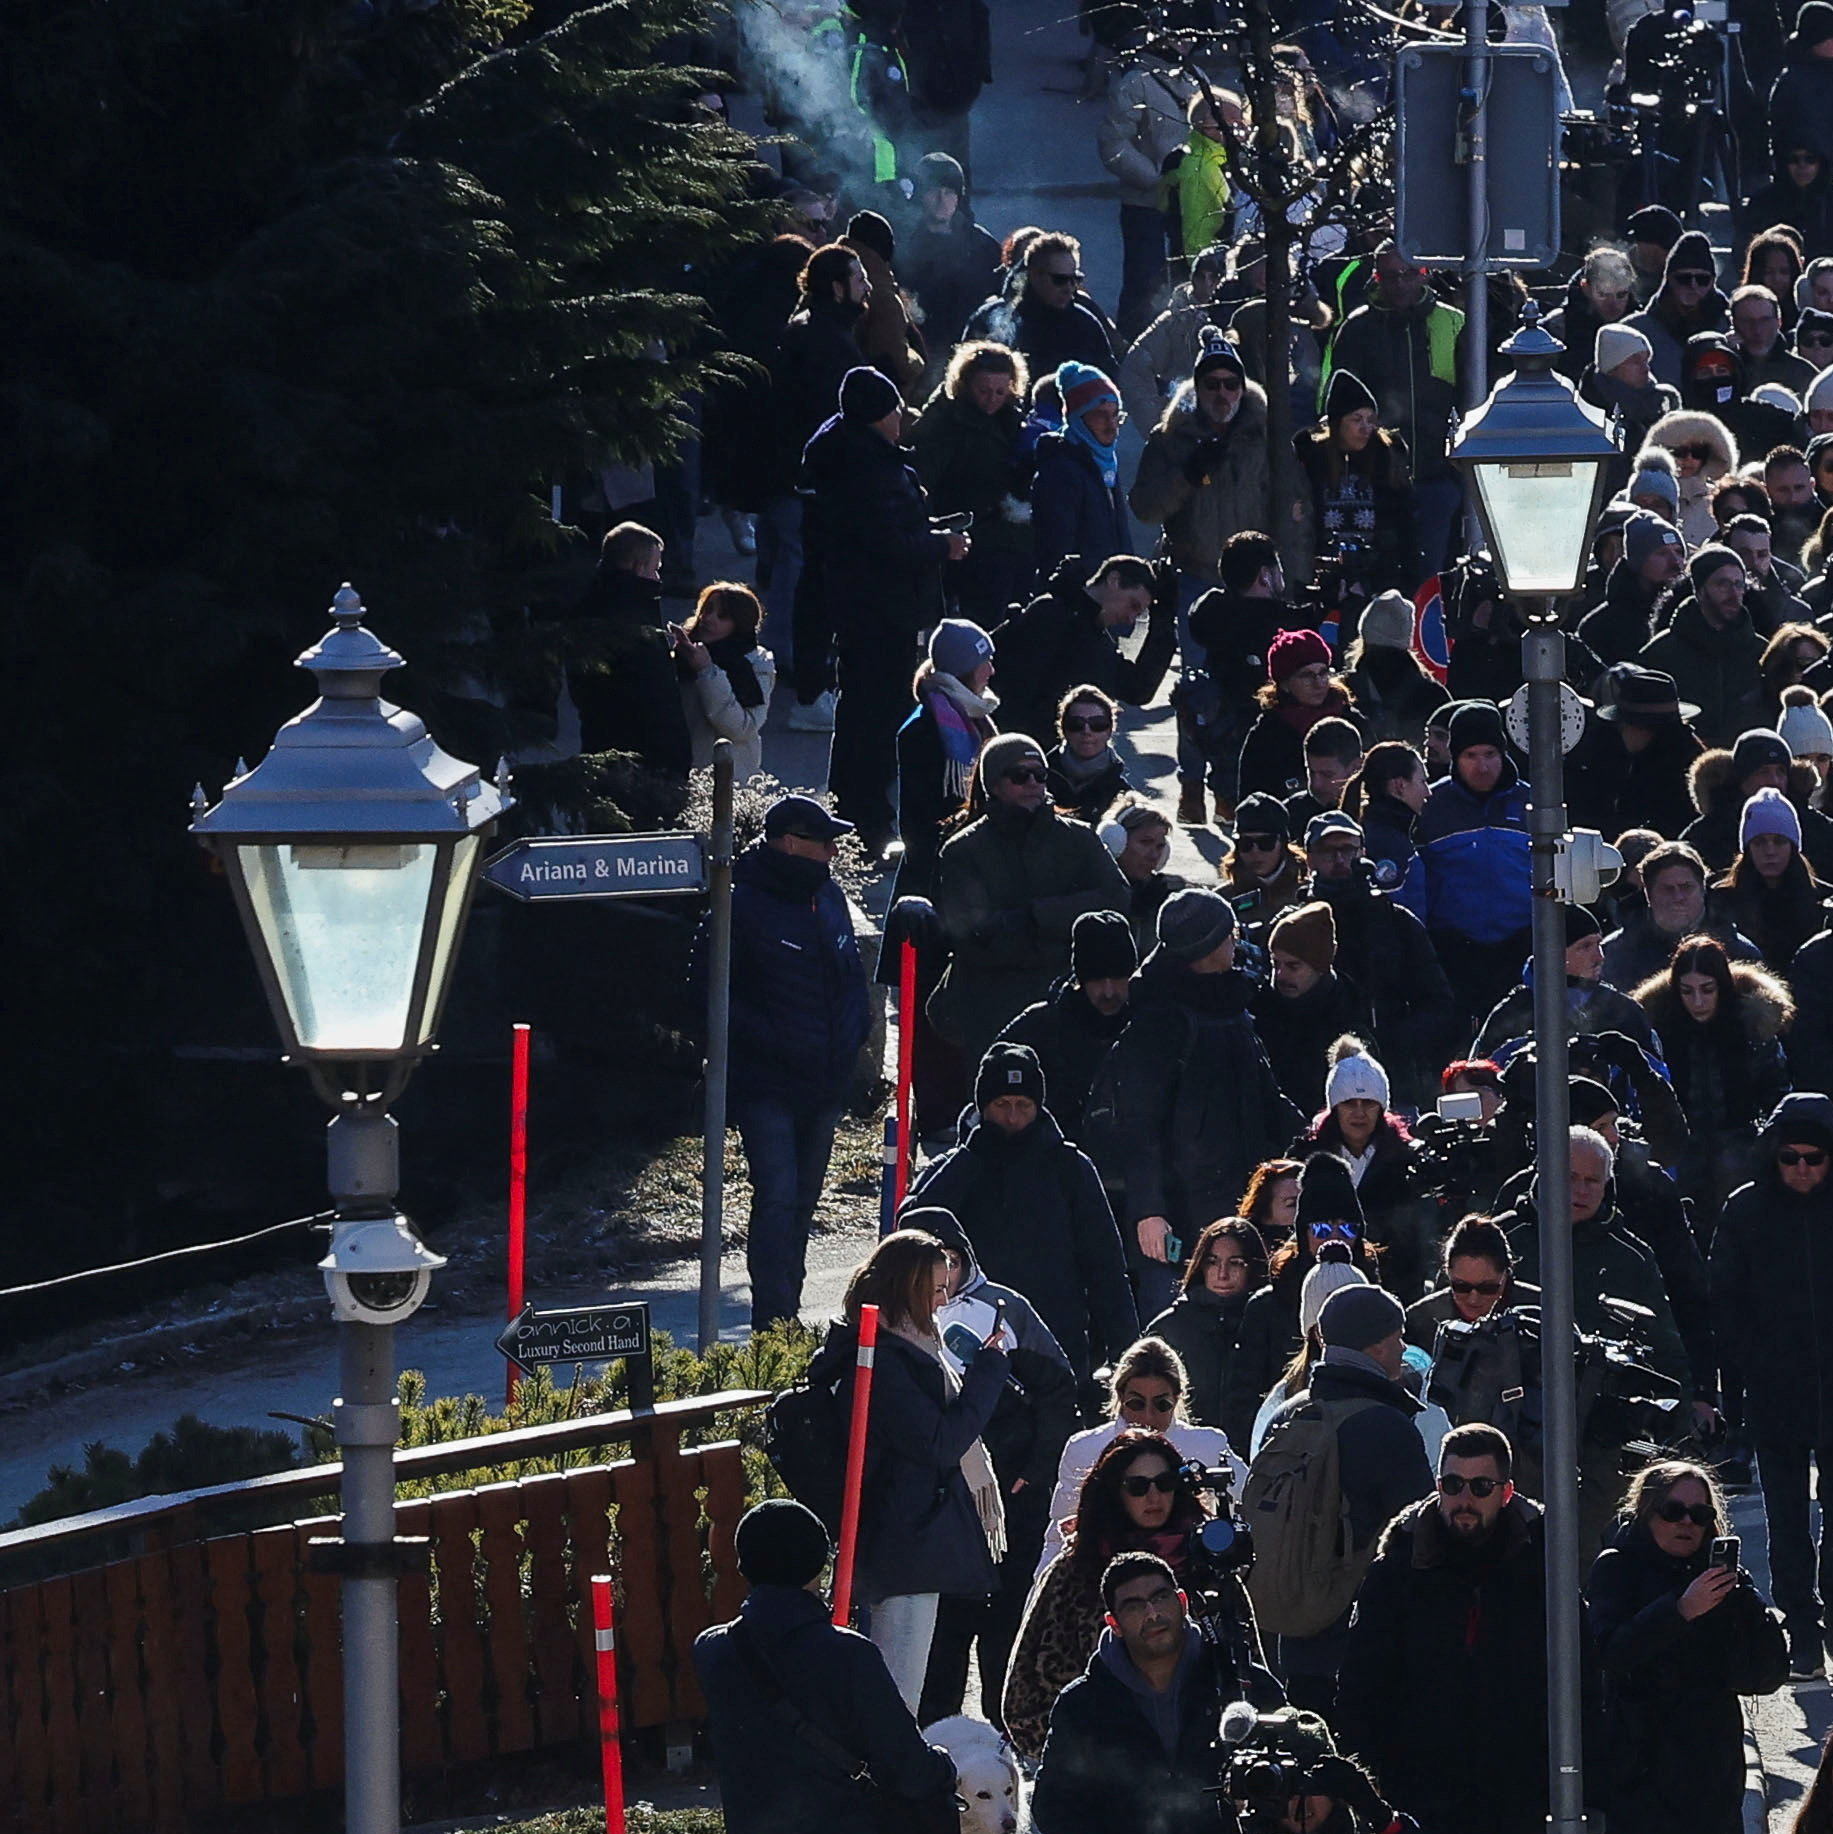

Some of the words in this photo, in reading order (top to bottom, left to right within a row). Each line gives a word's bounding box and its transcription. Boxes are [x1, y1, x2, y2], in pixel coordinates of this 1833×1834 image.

[520, 861, 587, 882] Ariana
[595, 859, 609, 878] &
[617, 855, 689, 877] Marina
[518, 1343, 560, 1359] Luxury
[563, 1336, 605, 1354] Second
[608, 1332, 639, 1350] Hand
